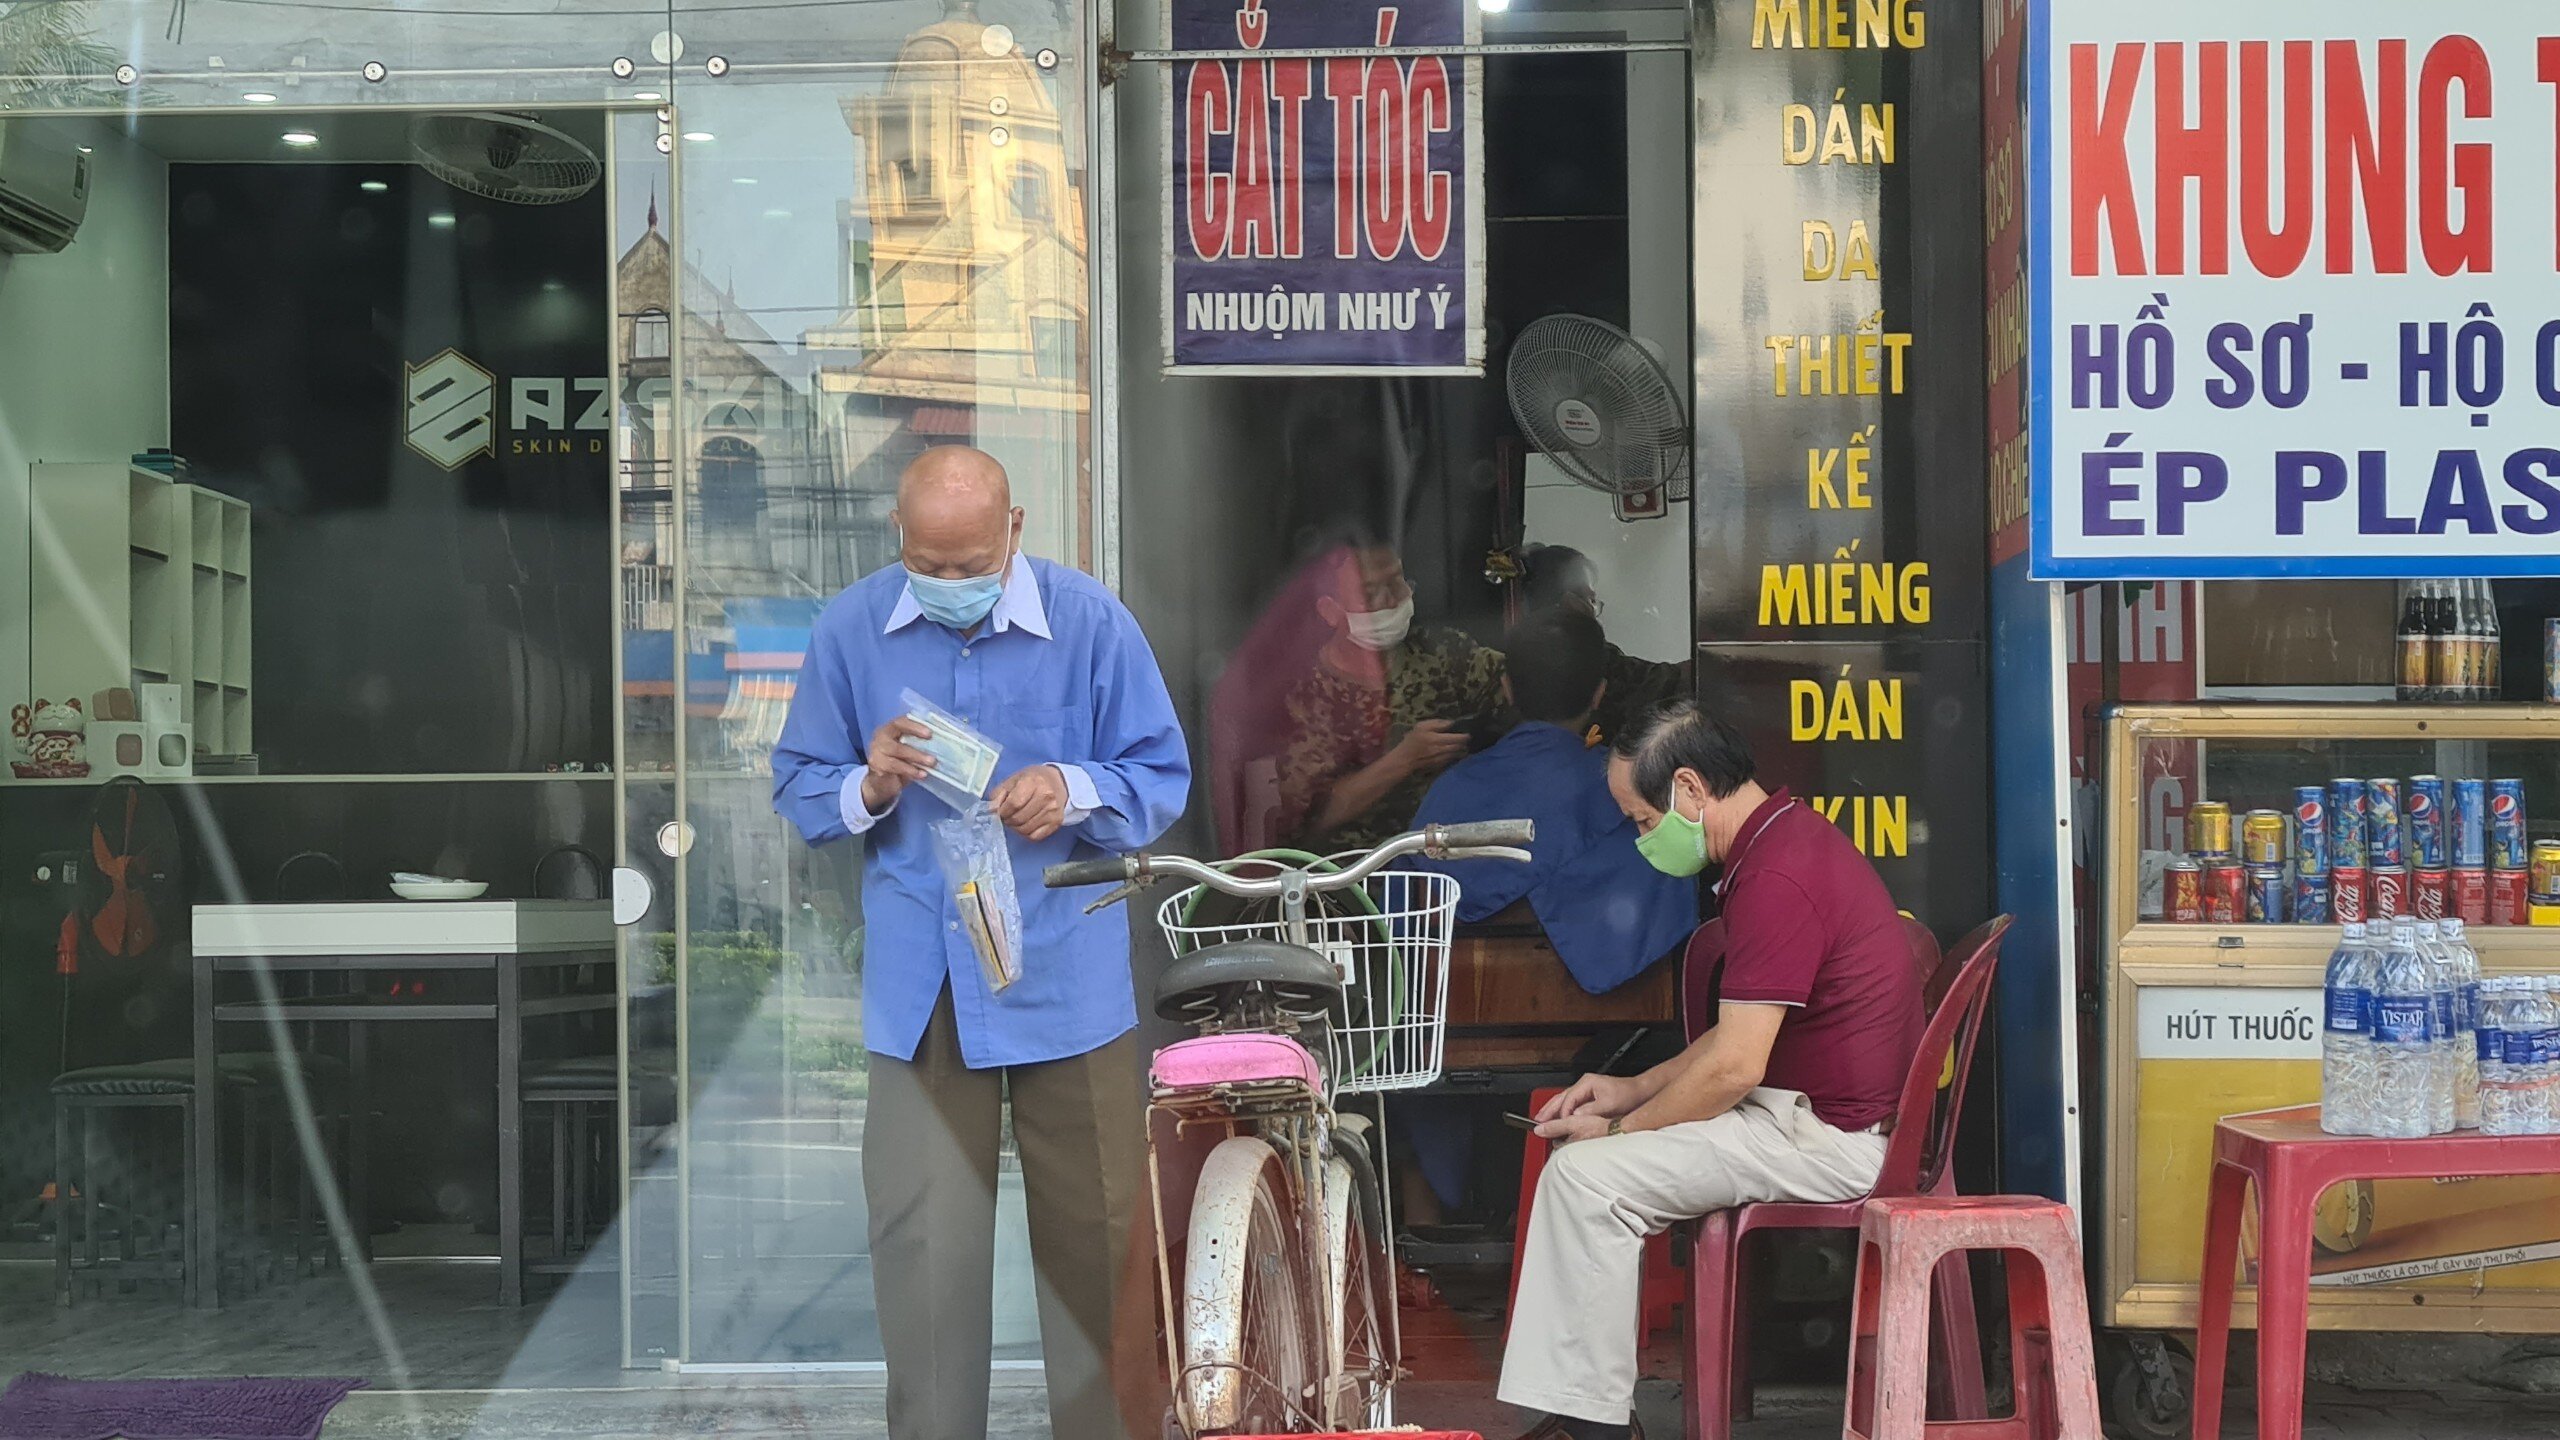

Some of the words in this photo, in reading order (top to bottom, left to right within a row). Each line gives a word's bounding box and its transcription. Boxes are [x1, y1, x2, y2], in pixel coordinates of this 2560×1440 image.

[1324, 7, 1452, 262] TÓC
[1782, 88, 1895, 166] DÁN
[2070, 34, 2493, 278] KHUNG
[1802, 219, 1879, 282] DA
[1187, 284, 1325, 340] NHUỘM
[1338, 287, 1420, 331] NHƯ
[1429, 283, 1451, 330] Ý
[1765, 310, 1913, 397] THIẾT
[2070, 293, 2175, 409] HỒ
[2205, 313, 2313, 409] SƠ
[2400, 302, 2504, 427] HỘ
[512, 438, 571, 454] SKIN
[1807, 425, 1876, 510] KẾ
[2081, 433, 2229, 536] ÉP
[1757, 539, 1931, 626] MIẾNG
[1791, 664, 1903, 742] DÁN
[2333, 879, 2360, 923] Cola
[2167, 1009, 2217, 1039] HÚT
[2228, 1007, 2314, 1041] THUỐC
